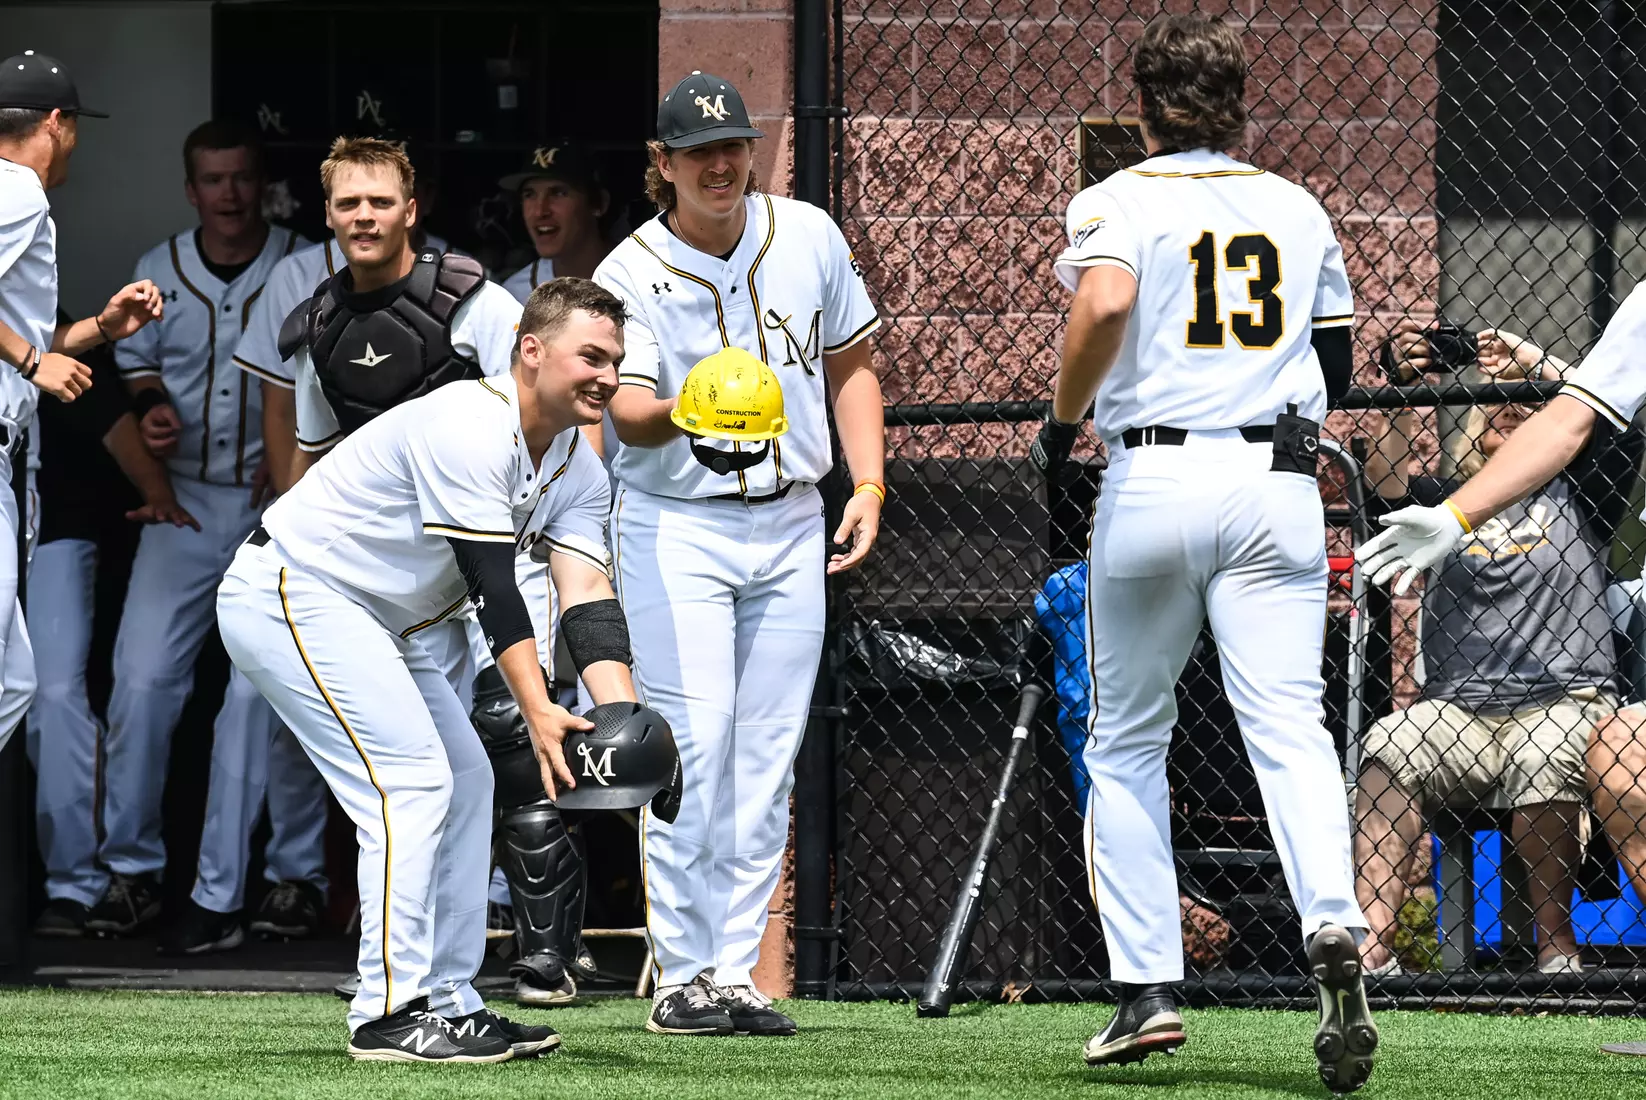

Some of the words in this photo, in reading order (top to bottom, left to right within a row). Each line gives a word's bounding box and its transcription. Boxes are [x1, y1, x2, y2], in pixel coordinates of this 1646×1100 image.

[694, 94, 727, 121] M
[532, 148, 560, 168] M
[1184, 229, 1285, 351] 13
[763, 308, 823, 376] M
[715, 408, 762, 417] CONSTRUCTION
[577, 742, 617, 786] M
[400, 1027, 440, 1054] N
